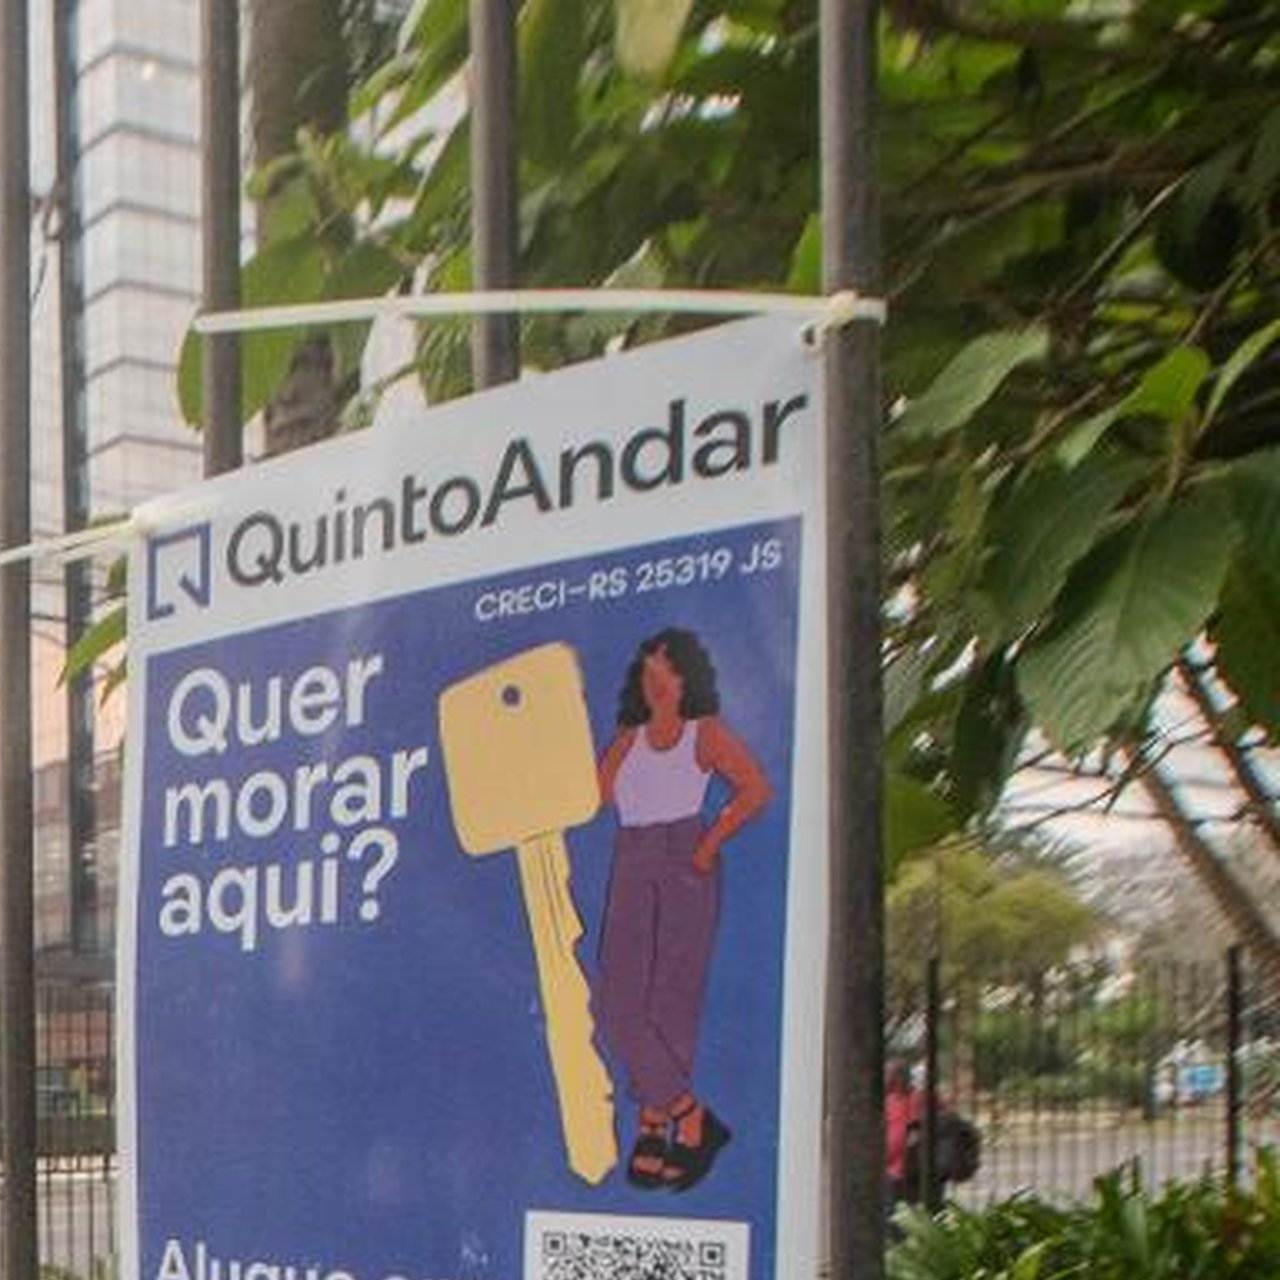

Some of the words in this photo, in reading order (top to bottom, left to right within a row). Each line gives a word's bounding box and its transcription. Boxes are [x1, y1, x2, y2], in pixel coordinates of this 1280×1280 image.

[225, 393, 809, 586] QuintoAndar
[474, 567, 628, 621] CRECI-RS
[635, 547, 733, 594] 25319
[741, 538, 783, 574] JS
[167, 653, 384, 757] Quer
[162, 746, 428, 848] morar
[158, 826, 399, 952] aqui?
